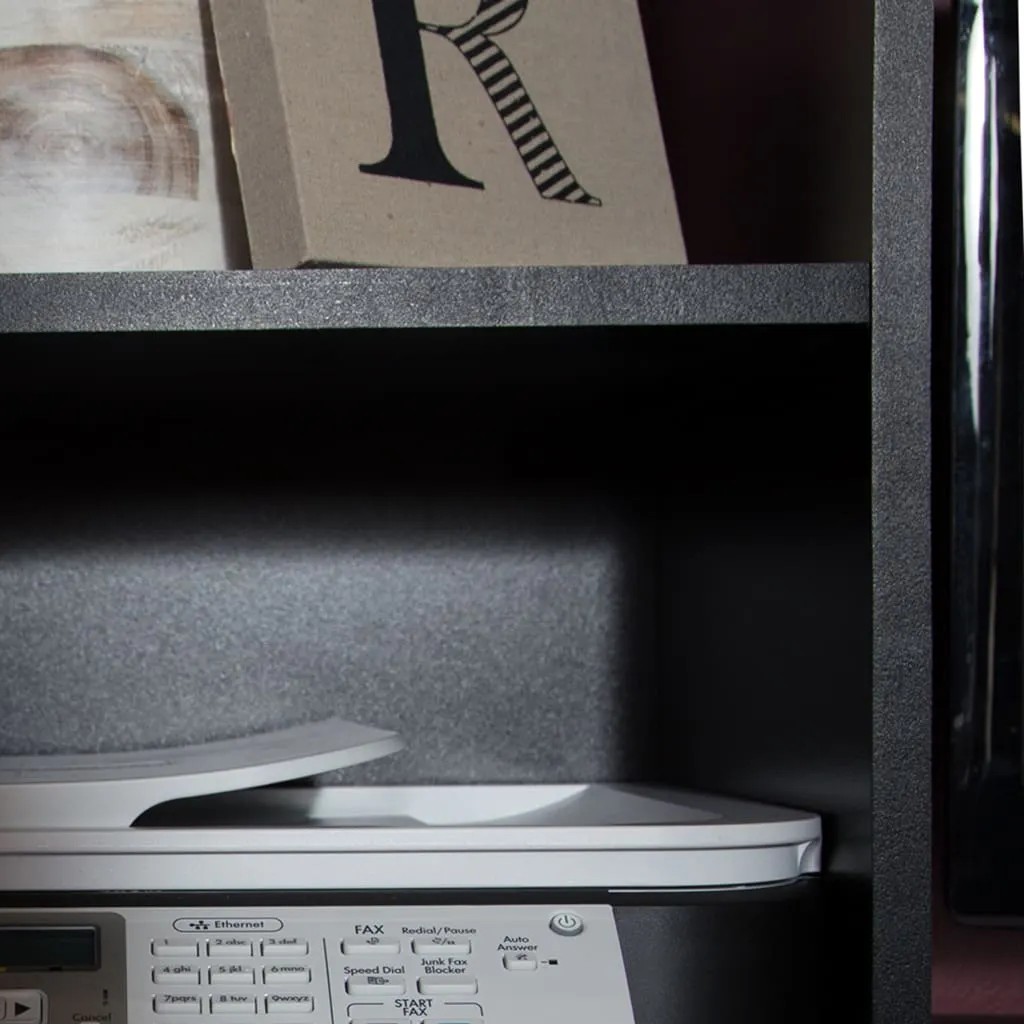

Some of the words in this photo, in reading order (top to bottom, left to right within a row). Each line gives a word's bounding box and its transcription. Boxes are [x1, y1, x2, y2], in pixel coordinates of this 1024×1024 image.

[214, 920, 265, 929] Ethernet
[354, 925, 384, 934] FAX
[401, 926, 477, 935] Redial/Pause
[497, 943, 538, 951] Answer
[420, 958, 445, 966] Junk
[344, 966, 380, 976] Speed
[382, 966, 405, 974] Dial
[424, 966, 466, 974] Blocker
[395, 999, 433, 1008] START
[403, 1007, 428, 1016] FAX
